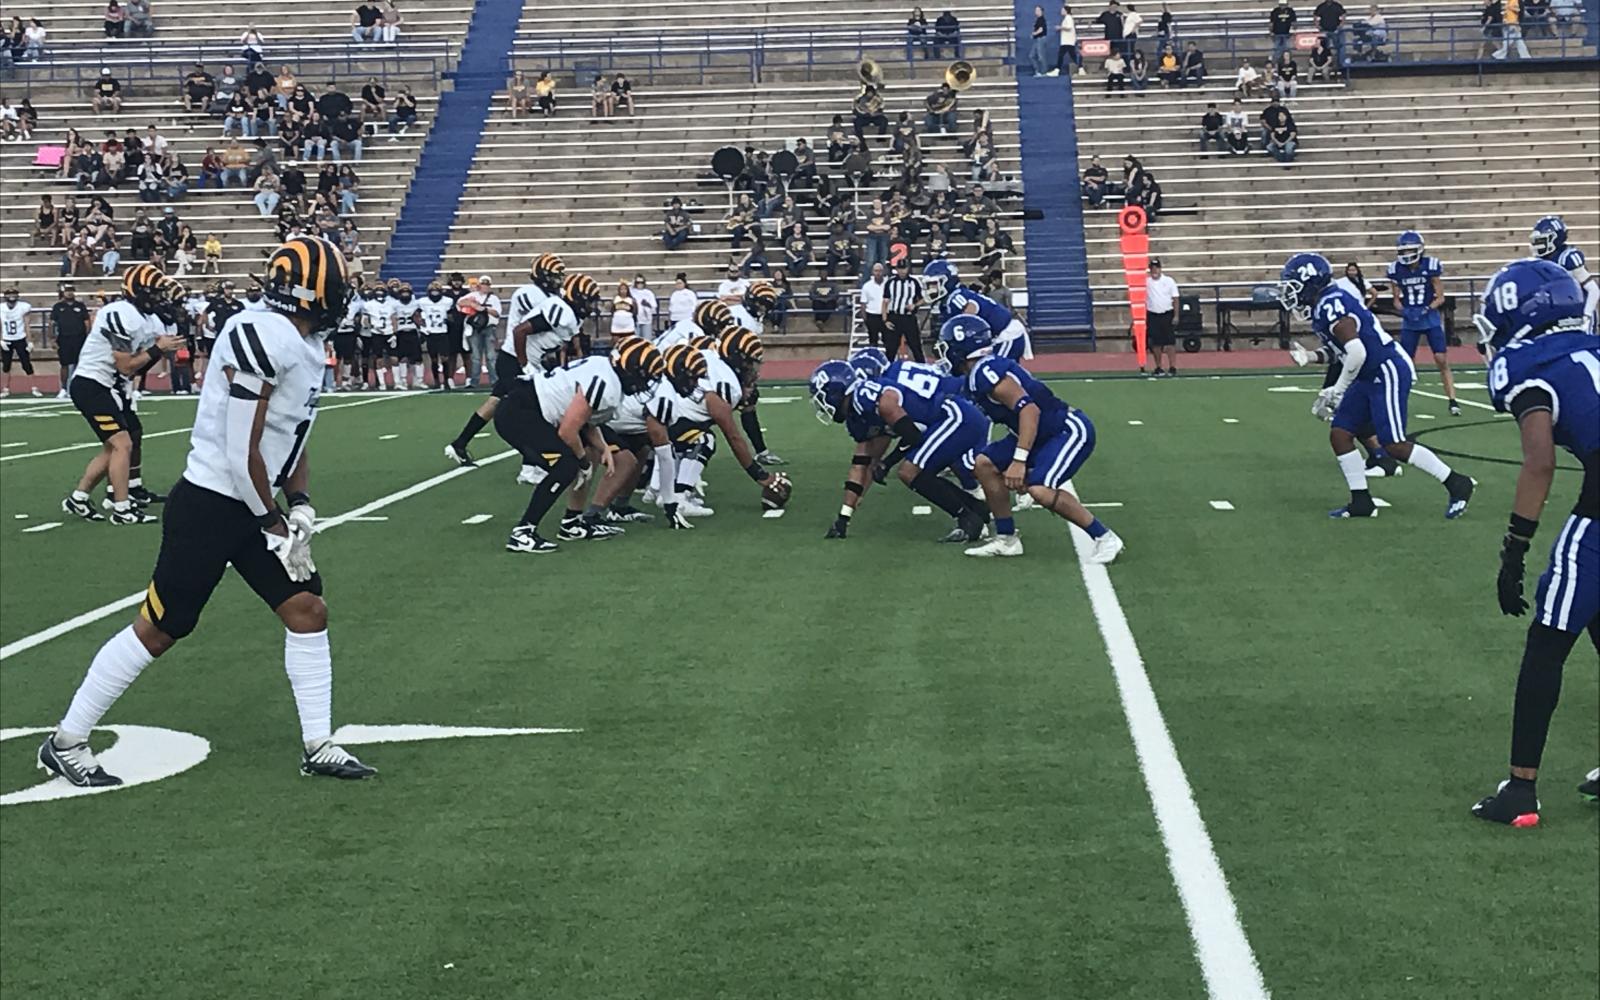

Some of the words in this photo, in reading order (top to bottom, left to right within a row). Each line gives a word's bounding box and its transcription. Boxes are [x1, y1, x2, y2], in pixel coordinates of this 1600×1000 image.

[1297, 262, 1317, 282] 24
[951, 294, 967, 310] 10
[1407, 284, 1425, 305] 17
[1493, 281, 1518, 314] 18
[1323, 298, 1346, 322] 24
[953, 325, 965, 341] 6
[982, 365, 1000, 384] 6
[859, 380, 882, 402] 20
